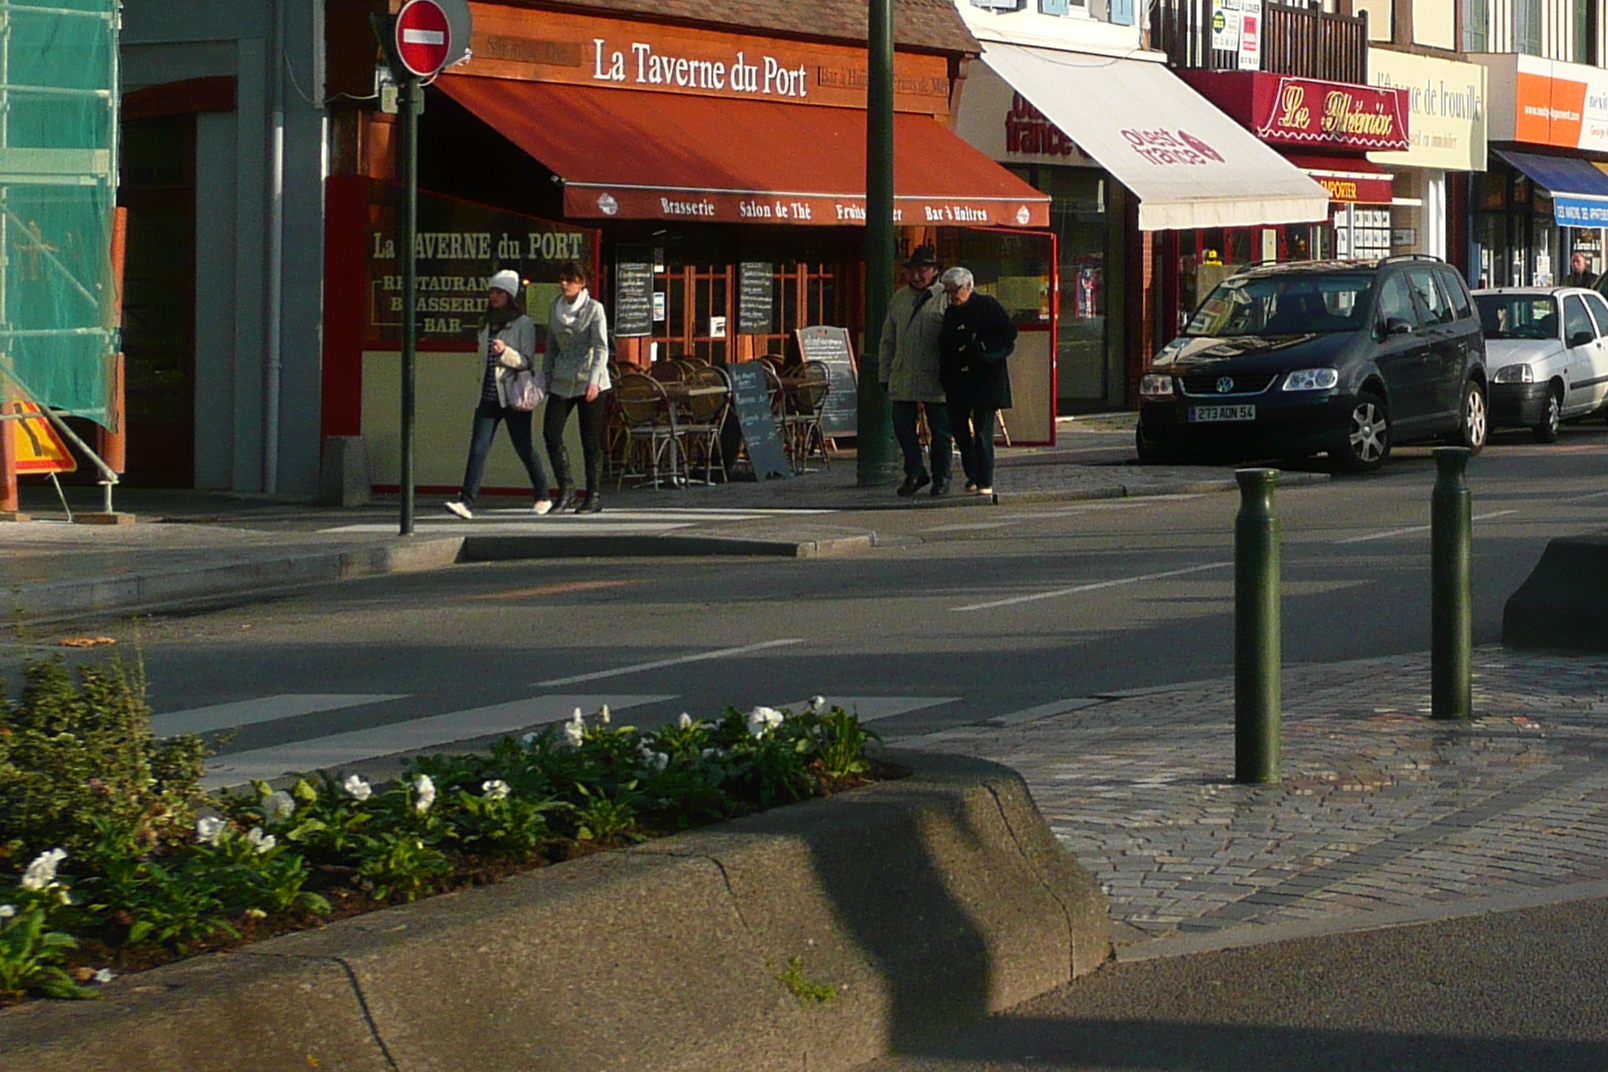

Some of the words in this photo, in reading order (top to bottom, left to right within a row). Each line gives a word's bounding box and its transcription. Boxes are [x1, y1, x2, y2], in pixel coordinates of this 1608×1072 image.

[593, 38, 626, 81] La
[632, 42, 725, 90] Taverne
[730, 51, 758, 93] du
[762, 56, 807, 98] Port
[1278, 85, 1311, 128] Le
[1424, 78, 1437, 116] de
[1439, 81, 1481, 121] Trouville
[1121, 128, 1185, 148] ouest
[1131, 144, 1207, 166] france
[1321, 180, 1357, 199] PORTER
[661, 197, 716, 217] Brasserie
[739, 201, 771, 218] Salon
[775, 201, 788, 219] de
[790, 202, 812, 220] Thé
[836, 204, 866, 221] Fruits
[925, 205, 944, 221] Bar
[373, 232, 395, 259] La
[414, 232, 491, 260] AVERNE
[497, 232, 521, 260] du
[528, 232, 583, 260] PORT
[382, 275, 490, 291] RTAURAN
[390, 297, 489, 313] BASSERI
[423, 317, 463, 333] BAR
